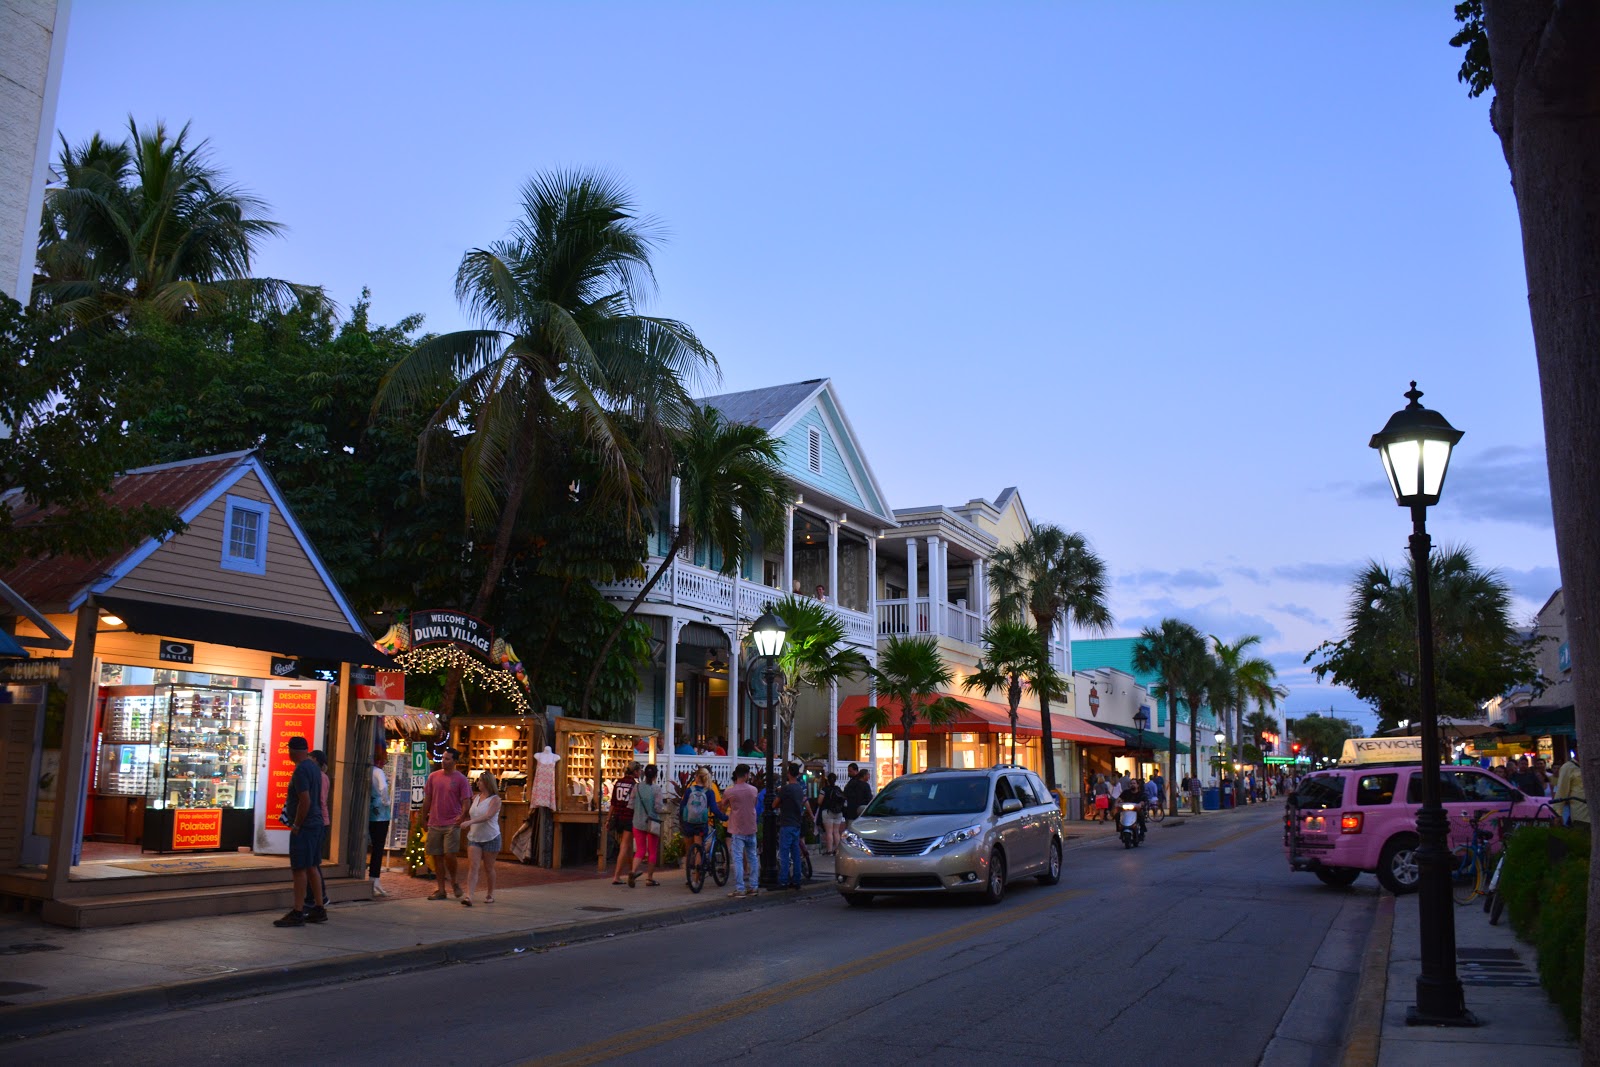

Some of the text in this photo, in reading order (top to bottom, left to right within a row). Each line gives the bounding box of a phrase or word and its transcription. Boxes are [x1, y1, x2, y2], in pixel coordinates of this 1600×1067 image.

[430, 614, 478, 630] WELCOME TO
[414, 626, 490, 652] DUVAL VILLAGE
[160, 653, 192, 661] OAKLEY
[279, 692, 312, 700] DESIGNER
[273, 702, 316, 710] SUNGLASSES
[415, 753, 423, 768] 0
[412, 775, 424, 786] END
[180, 821, 216, 831] Polarized
[176, 834, 218, 845] Sunglasses
